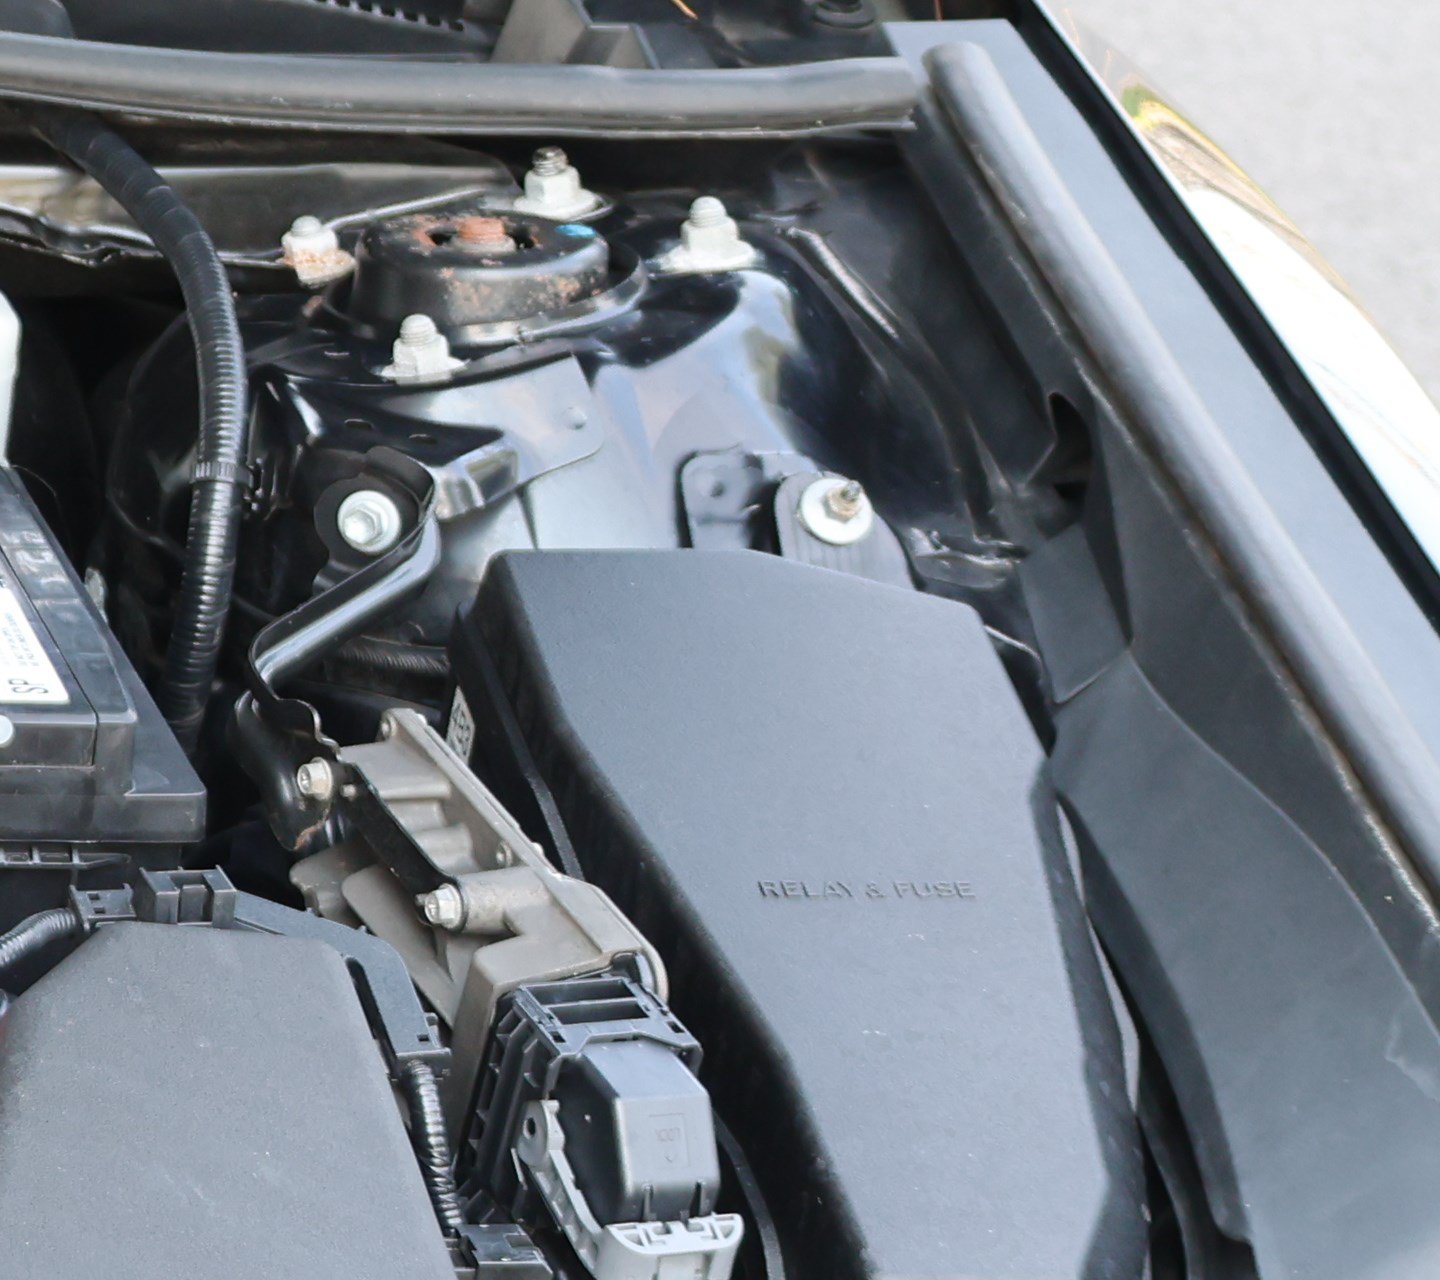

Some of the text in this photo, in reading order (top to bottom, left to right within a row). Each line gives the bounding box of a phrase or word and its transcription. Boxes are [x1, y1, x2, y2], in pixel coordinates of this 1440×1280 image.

[757, 880, 976, 898] RELAY & FUSE
